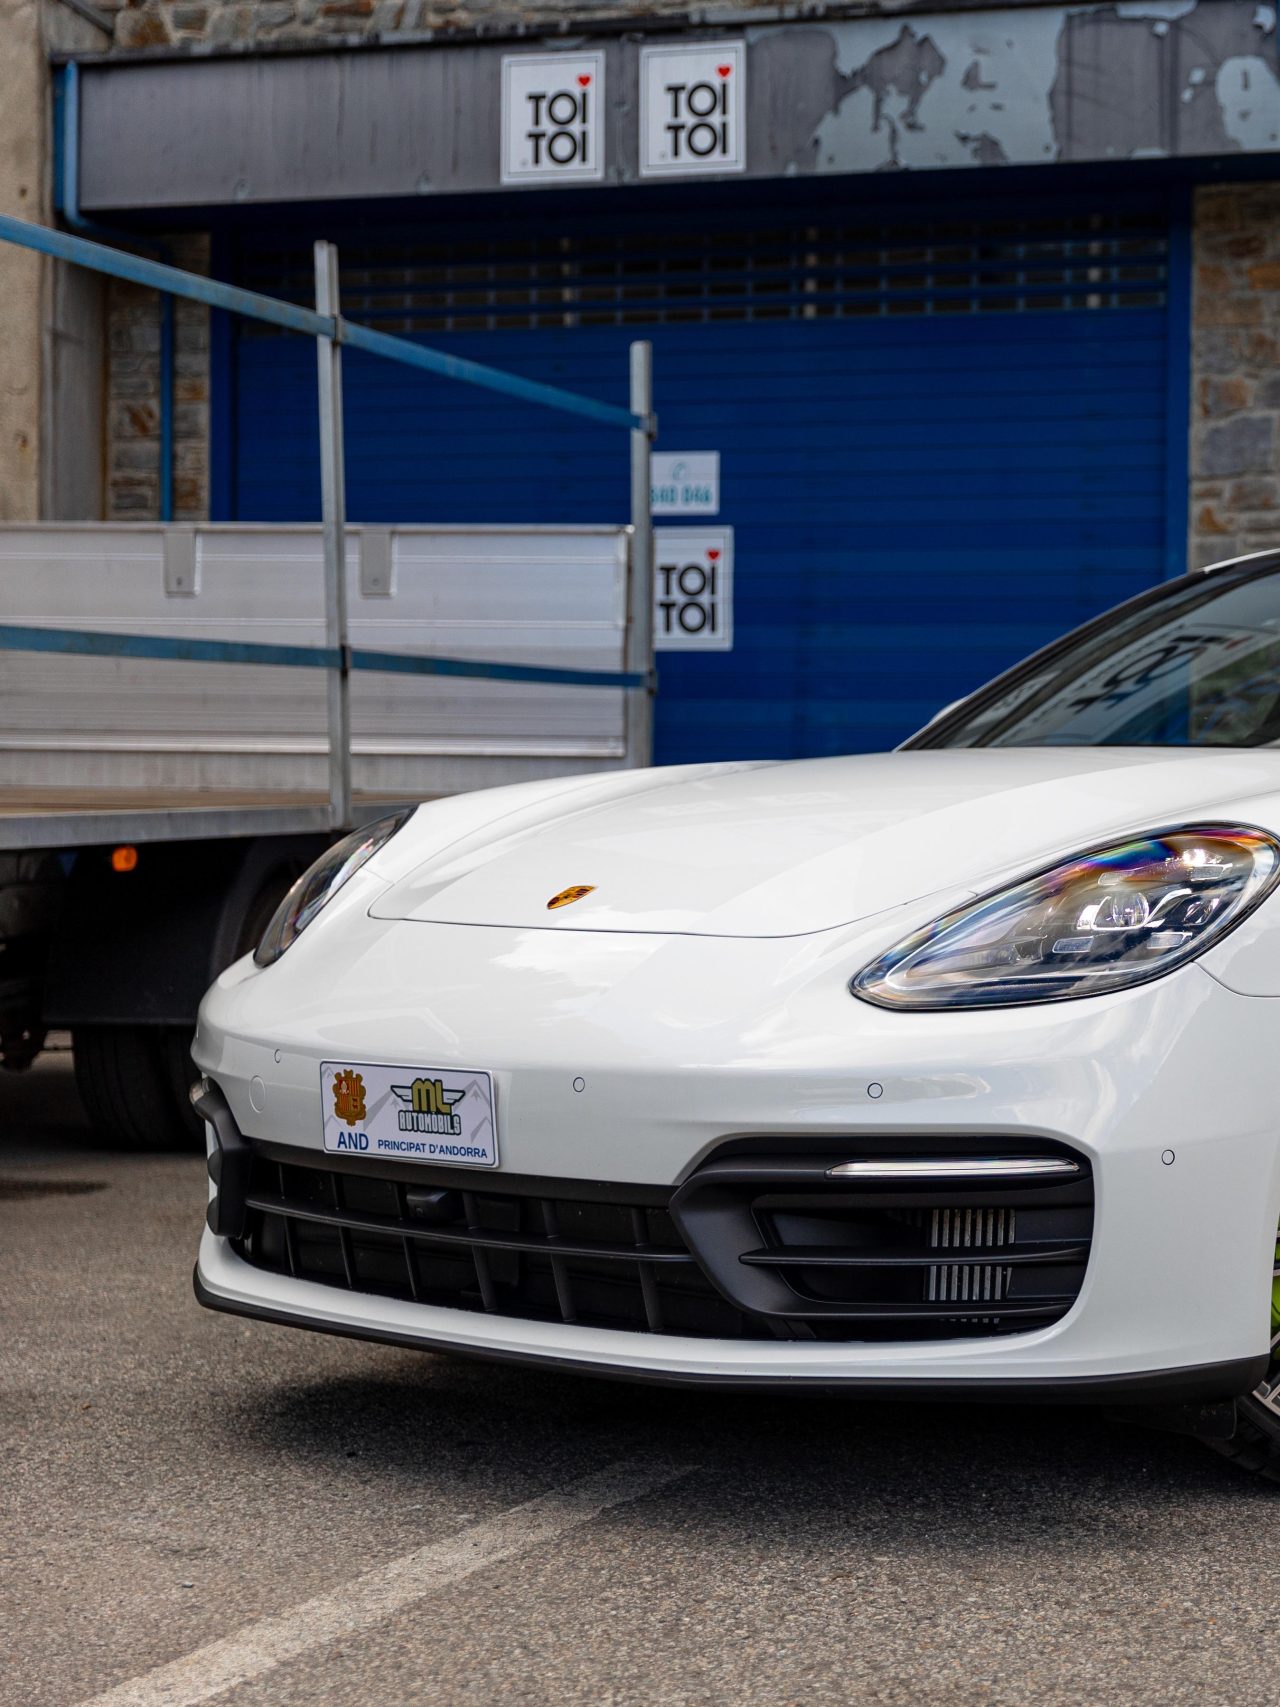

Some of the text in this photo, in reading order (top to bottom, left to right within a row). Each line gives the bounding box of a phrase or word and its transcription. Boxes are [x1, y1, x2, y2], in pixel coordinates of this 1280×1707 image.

[527, 91, 587, 126] TOI
[666, 82, 728, 118] TOI
[527, 130, 587, 165] TOI
[666, 122, 728, 157] TOI
[659, 564, 716, 596] TOI
[659, 602, 716, 633] TOI
[411, 1078, 453, 1114] ML
[336, 1131, 488, 1158] AND PRINCIPAT D'ANDORRA
